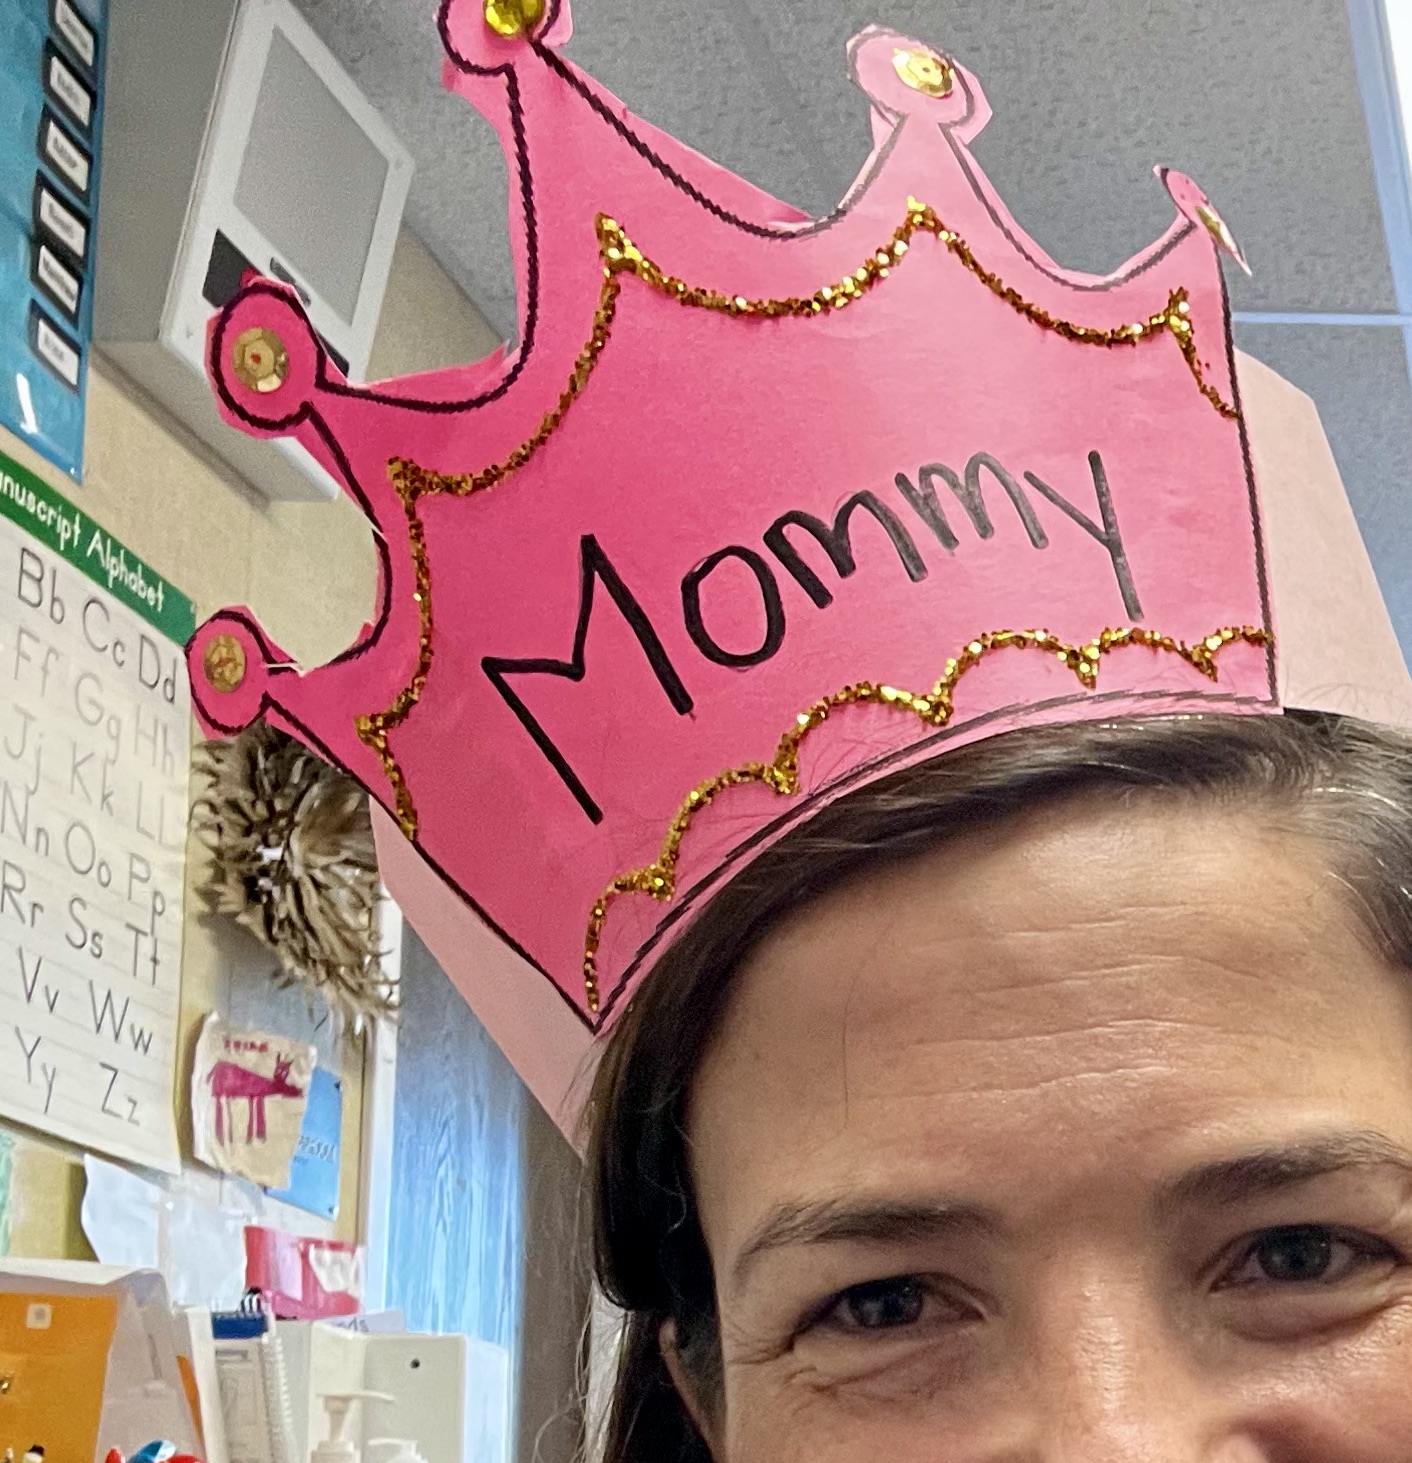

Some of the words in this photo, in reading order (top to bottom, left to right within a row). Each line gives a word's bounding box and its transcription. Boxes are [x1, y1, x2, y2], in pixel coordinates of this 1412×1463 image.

[18, 547, 65, 624] Bb
[82, 596, 126, 667] Cc
[138, 634, 178, 704] Dd
[86, 529, 164, 613] Alphabet
[481, 449, 1144, 826] Mommy
[14, 625, 59, 698] Ff
[75, 671, 122, 765] Gg
[134, 704, 175, 777] Hh
[4, 702, 42, 796] Jj
[70, 741, 114, 817] Kk
[136, 780, 166, 845] Ll
[0, 859, 44, 928] Rr
[65, 896, 104, 959] Ss
[125, 922, 160, 986] Tt
[1, 780, 50, 858] Nn
[65, 821, 112, 888] Oo
[127, 852, 166, 937] Pp
[18, 946, 59, 1014] Vv
[88, 979, 153, 1056] Ww
[14, 1025, 57, 1115] Yy
[99, 1061, 141, 1127] Zz
